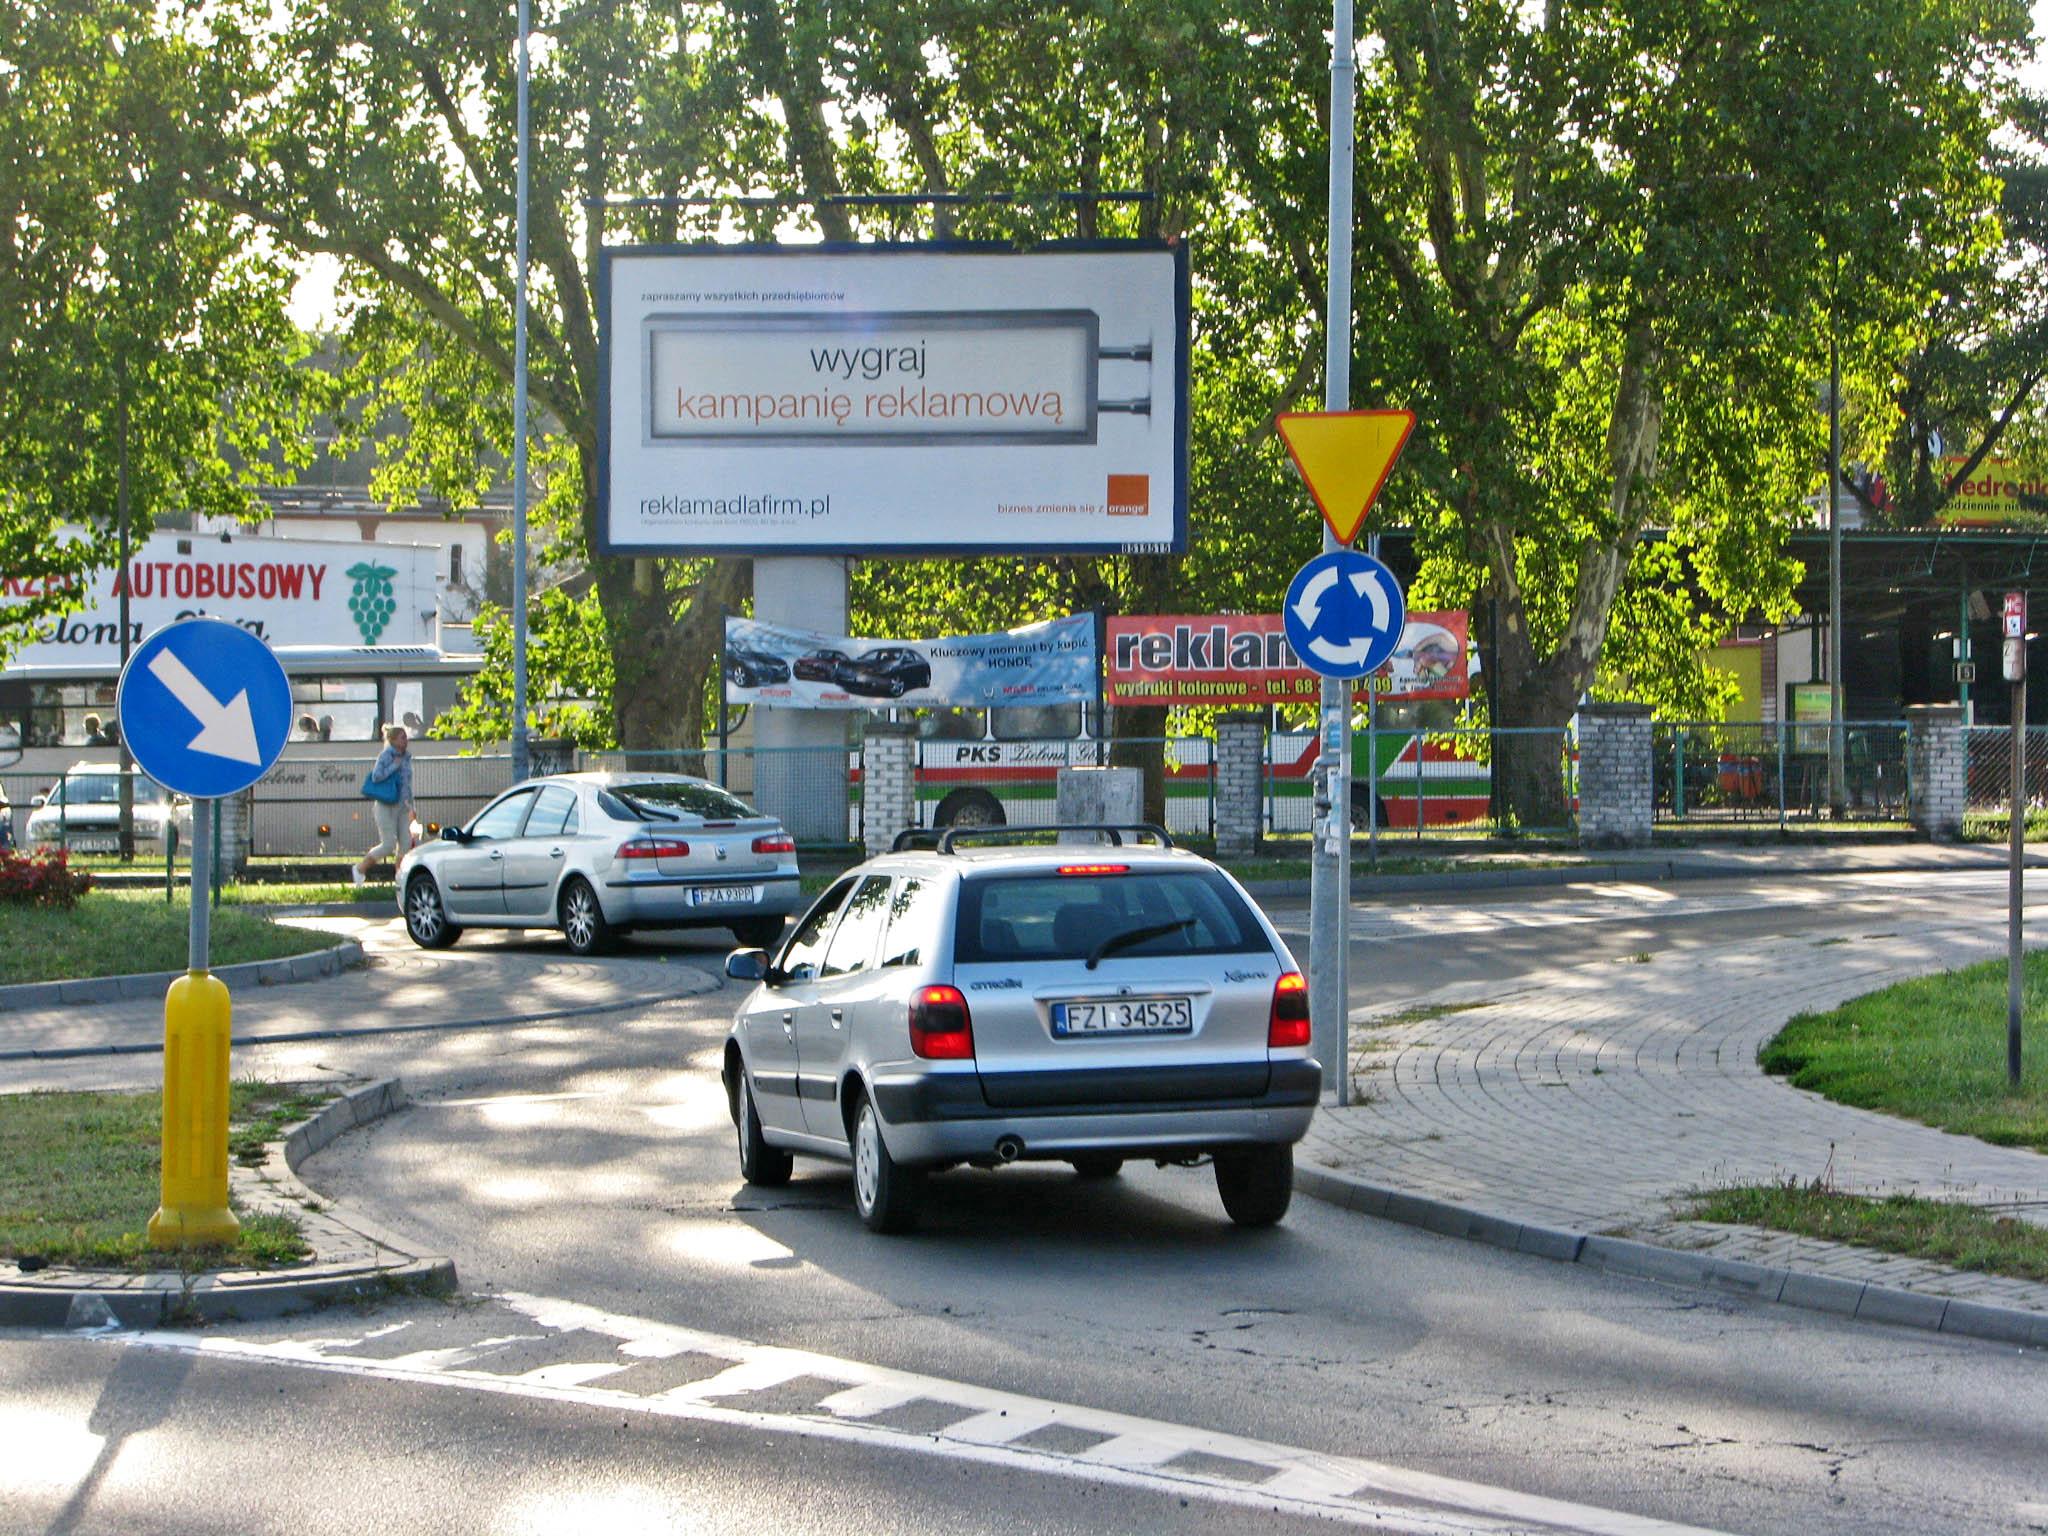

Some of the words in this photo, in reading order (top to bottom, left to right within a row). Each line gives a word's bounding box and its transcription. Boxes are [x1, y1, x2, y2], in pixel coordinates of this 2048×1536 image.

[641, 292, 700, 302] zapraszamy
[704, 291, 758, 301] wszystkich
[762, 291, 845, 302] przedsiębiorców
[810, 340, 926, 380] wygraj
[677, 387, 851, 426] kampanię
[865, 386, 1064, 425] reklamową
[640, 494, 830, 519] reklamadlafirm.pl
[997, 503, 1033, 513] biznes
[1036, 504, 1076, 513] zmienia
[1079, 503, 1095, 514] się
[1098, 505, 1104, 513] z
[1108, 505, 1145, 514] orange
[112, 562, 327, 600] AUTOBUSOWY
[930, 645, 987, 658] Kluczowy
[988, 646, 1036, 656] moment
[1039, 643, 1054, 654] by
[1057, 638, 1089, 649] kupić
[1115, 680, 1173, 697] wydruki
[1178, 680, 1248, 696] kolorowe
[1266, 679, 1290, 695] tel.
[1295, 679, 1314, 693] 68
[956, 747, 1000, 762] PKS
[1068, 1007, 1106, 1029] FZI
[1120, 1003, 1187, 1028] 34525
